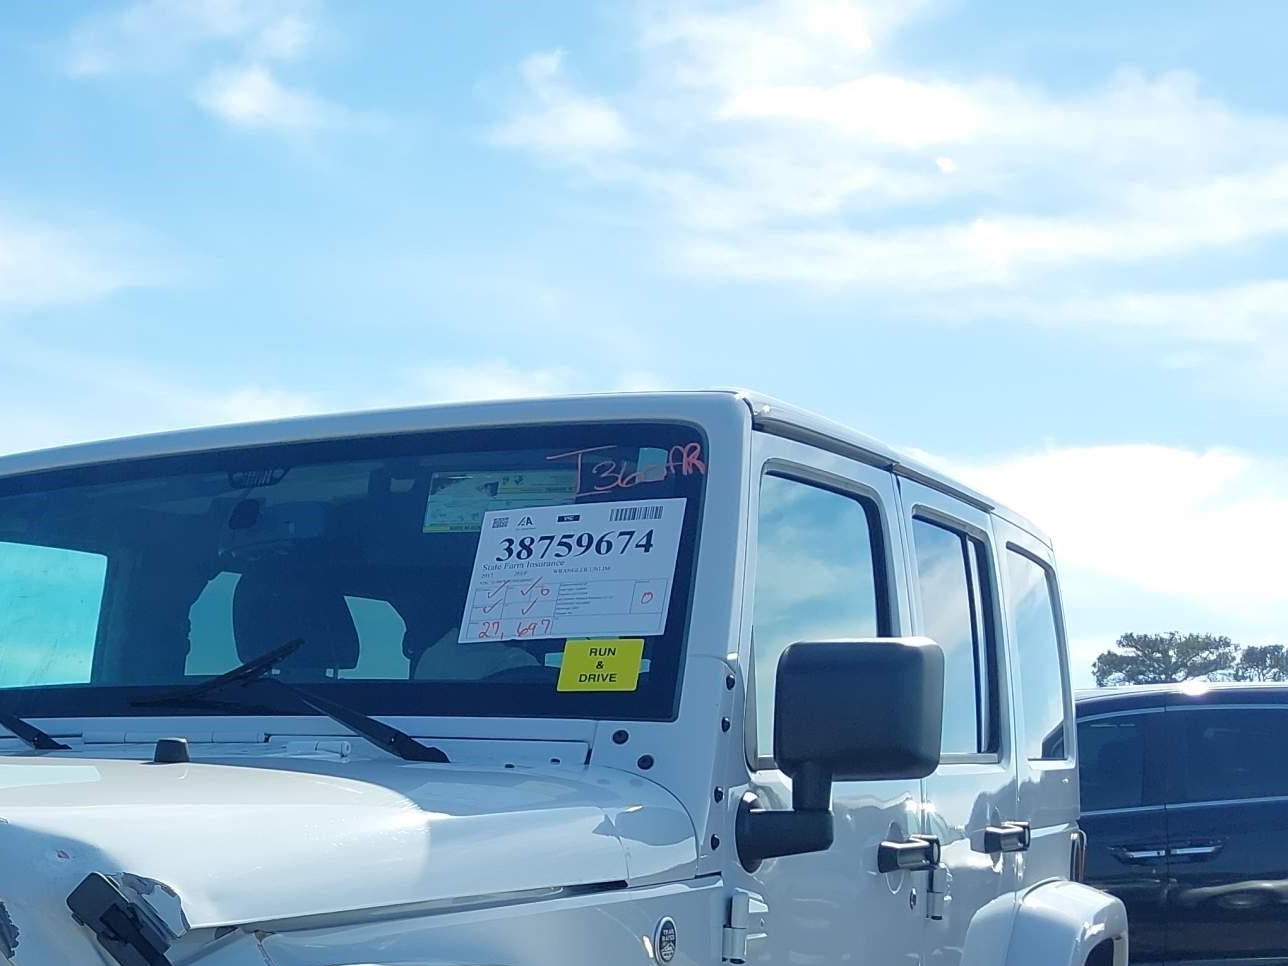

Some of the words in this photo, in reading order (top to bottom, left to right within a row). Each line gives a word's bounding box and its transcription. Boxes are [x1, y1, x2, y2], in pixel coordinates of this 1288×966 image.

[495, 529, 654, 562] 38759674
[482, 562, 502, 572] State
[504, 561, 525, 571] Farm
[526, 559, 566, 568] Insurance
[589, 647, 617, 657] RUN
[595, 660, 605, 670] &
[578, 673, 617, 683] DRIVE
